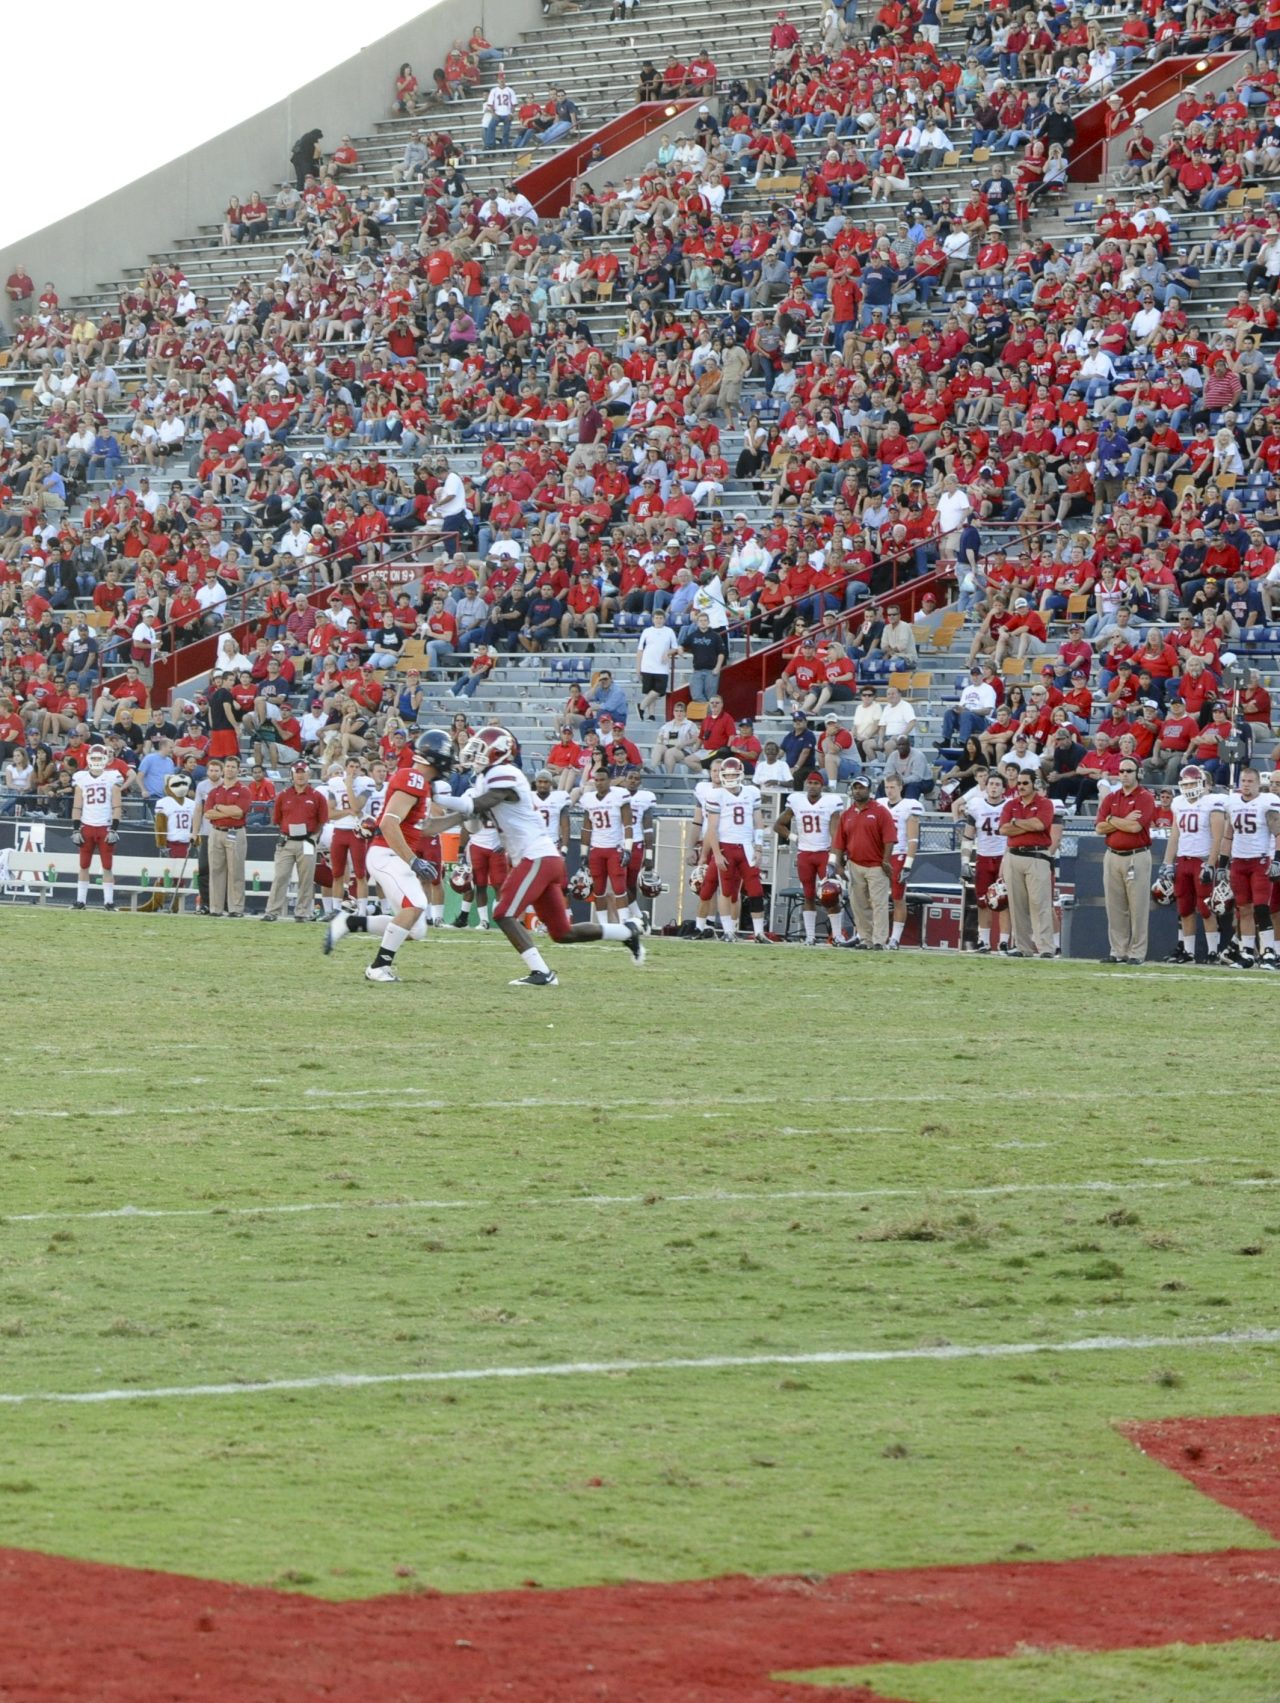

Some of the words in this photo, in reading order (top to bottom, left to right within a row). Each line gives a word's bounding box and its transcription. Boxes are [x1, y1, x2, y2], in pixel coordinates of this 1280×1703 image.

[86, 786, 107, 805] 23
[176, 814, 189, 829] 12
[592, 811, 612, 830] 31
[733, 806, 745, 825] 8
[802, 815, 822, 834] 81
[1179, 813, 1199, 833] 40
[1234, 813, 1257, 834] 45
